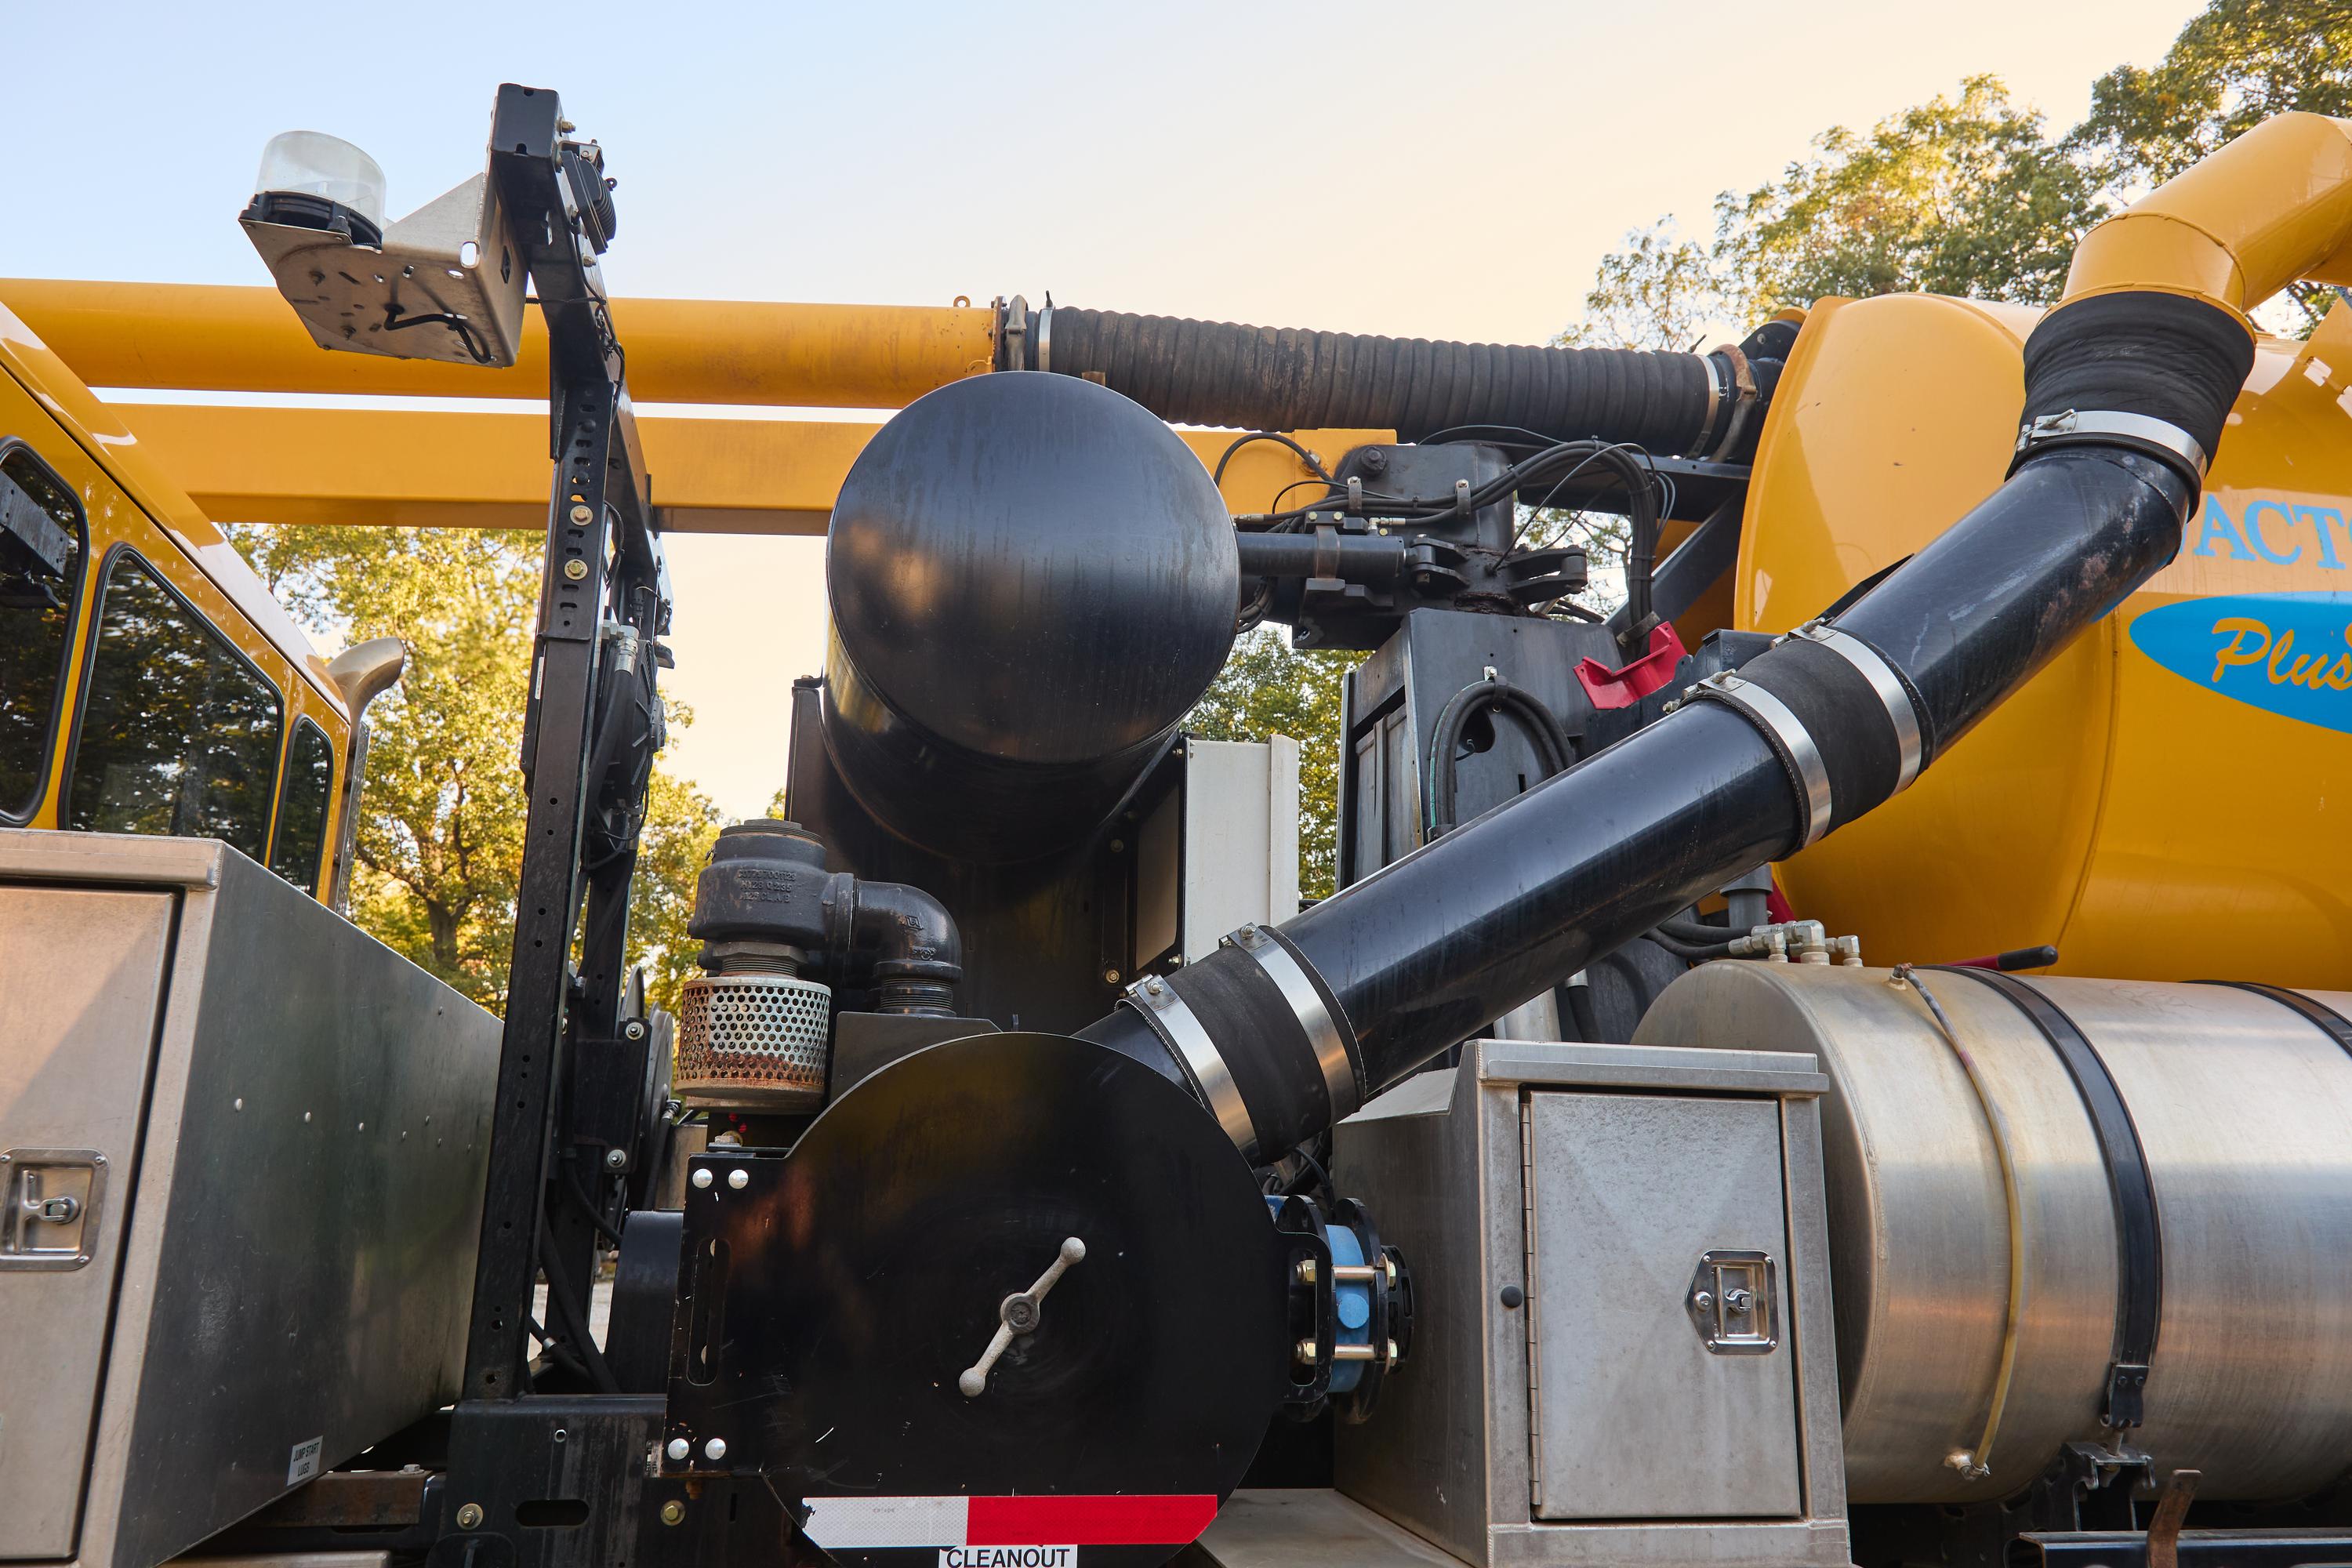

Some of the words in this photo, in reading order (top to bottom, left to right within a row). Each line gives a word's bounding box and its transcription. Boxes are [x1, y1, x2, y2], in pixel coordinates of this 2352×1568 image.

[2181, 494, 2352, 570] ACT
[305, 1442, 320, 1457] START
[297, 1461, 310, 1477] LUGS
[946, 1548, 1070, 1568] CLEANOUT
